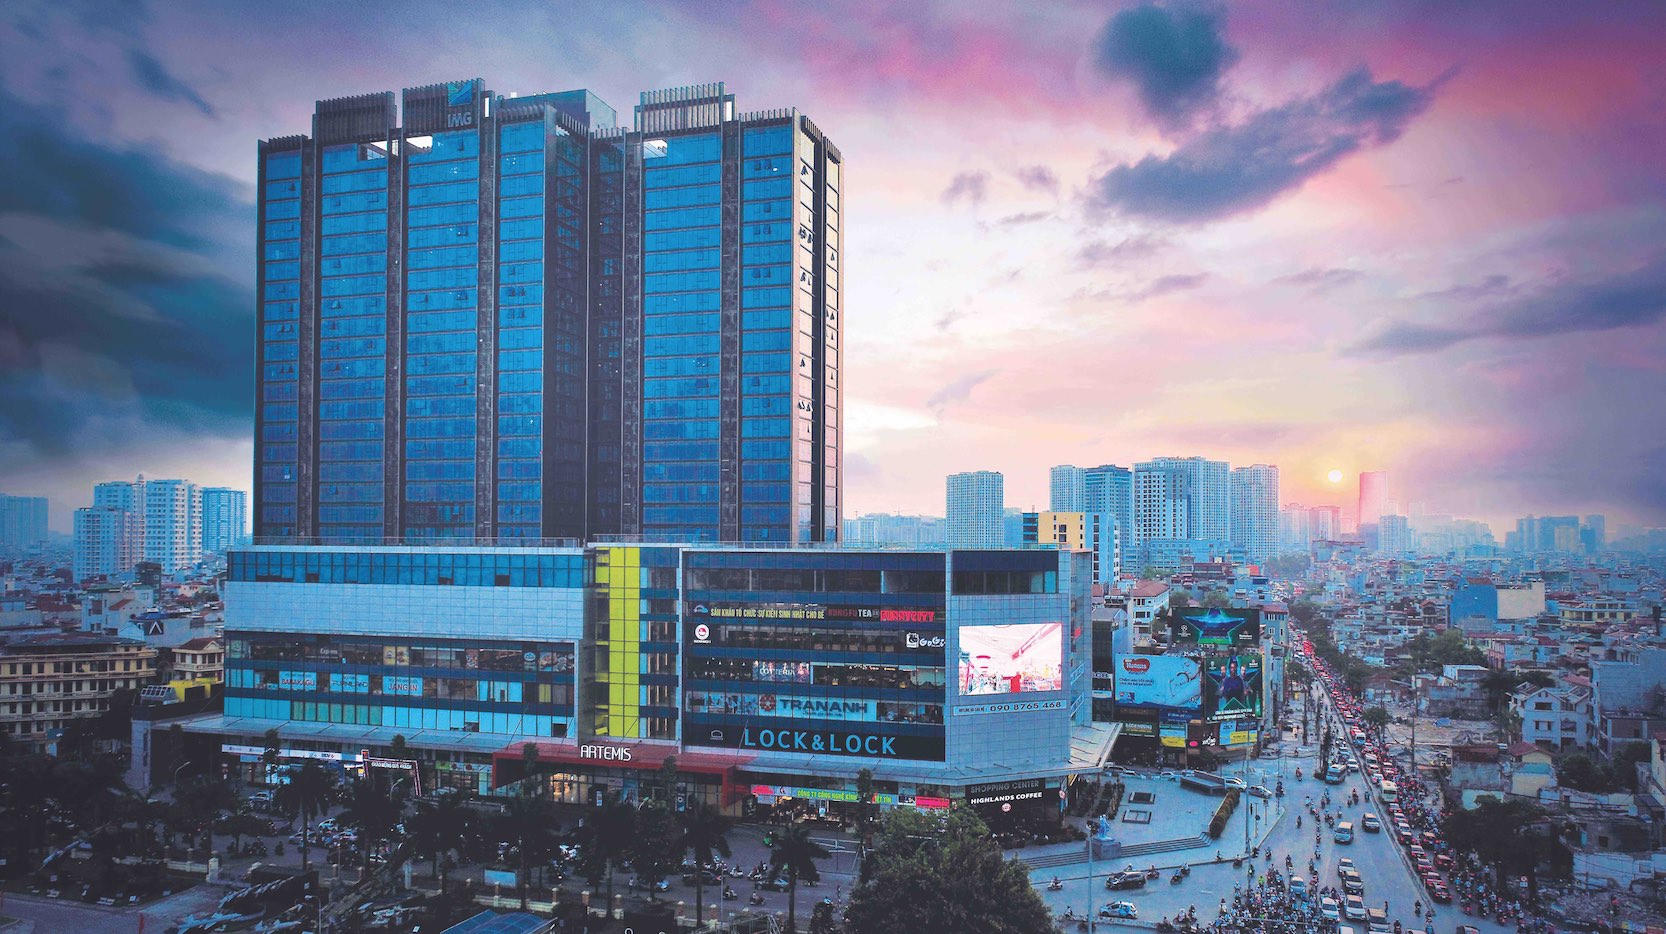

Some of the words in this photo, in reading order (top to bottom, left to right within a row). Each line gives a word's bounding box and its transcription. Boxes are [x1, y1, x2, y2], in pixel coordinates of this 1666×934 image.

[448, 112, 472, 127] IMG
[858, 609, 872, 618] TEA
[1013, 702, 1039, 711] 8765
[1042, 701, 1062, 709] 468
[745, 728, 897, 755] LOCK&LOCK
[580, 745, 632, 761] ARTEMIS
[970, 783, 1010, 794] SHOPPING
[1012, 780, 1040, 790] CENTER
[971, 794, 1015, 805] HIGHLANDS
[1015, 792, 1043, 800] COFFEE
